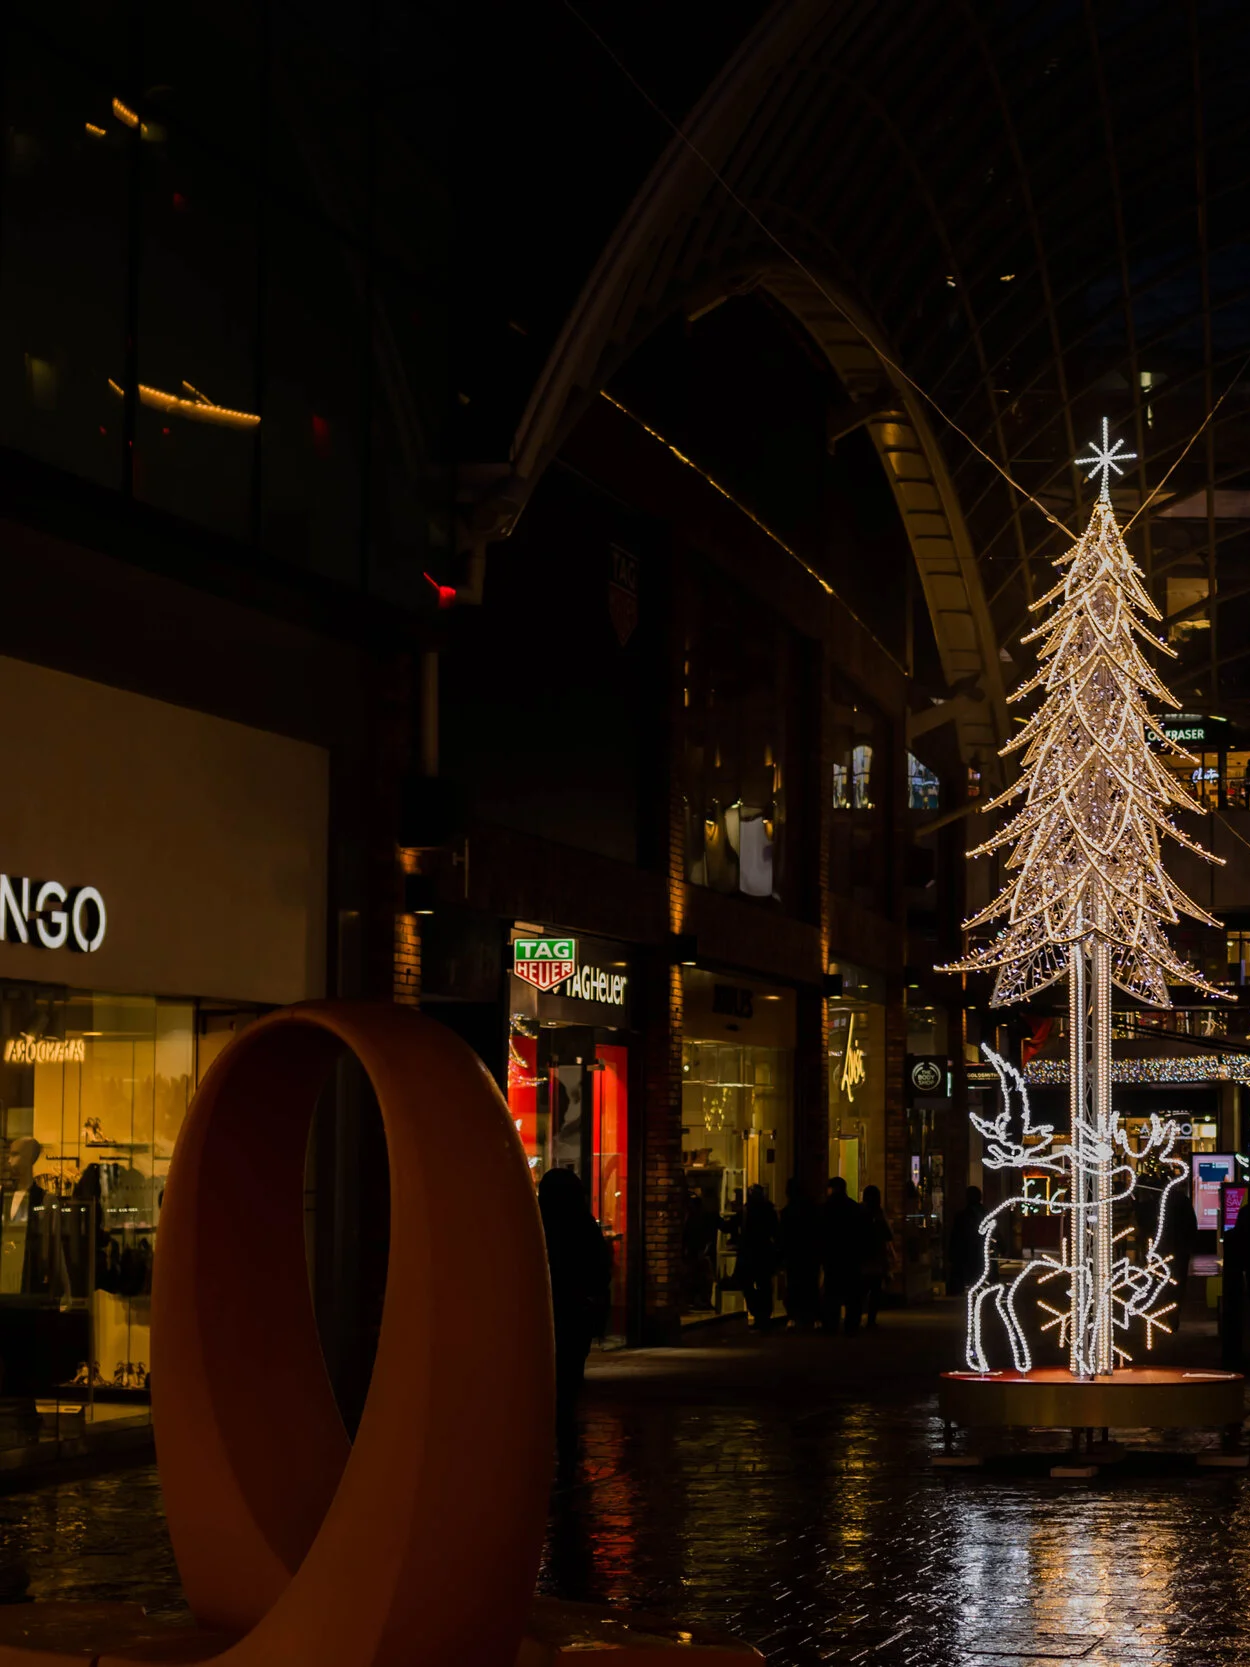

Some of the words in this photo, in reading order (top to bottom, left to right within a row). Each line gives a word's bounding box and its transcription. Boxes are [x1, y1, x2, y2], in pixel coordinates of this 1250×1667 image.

[0, 873, 108, 953] NGO
[519, 942, 570, 958] TAG
[517, 962, 571, 987] HEUER
